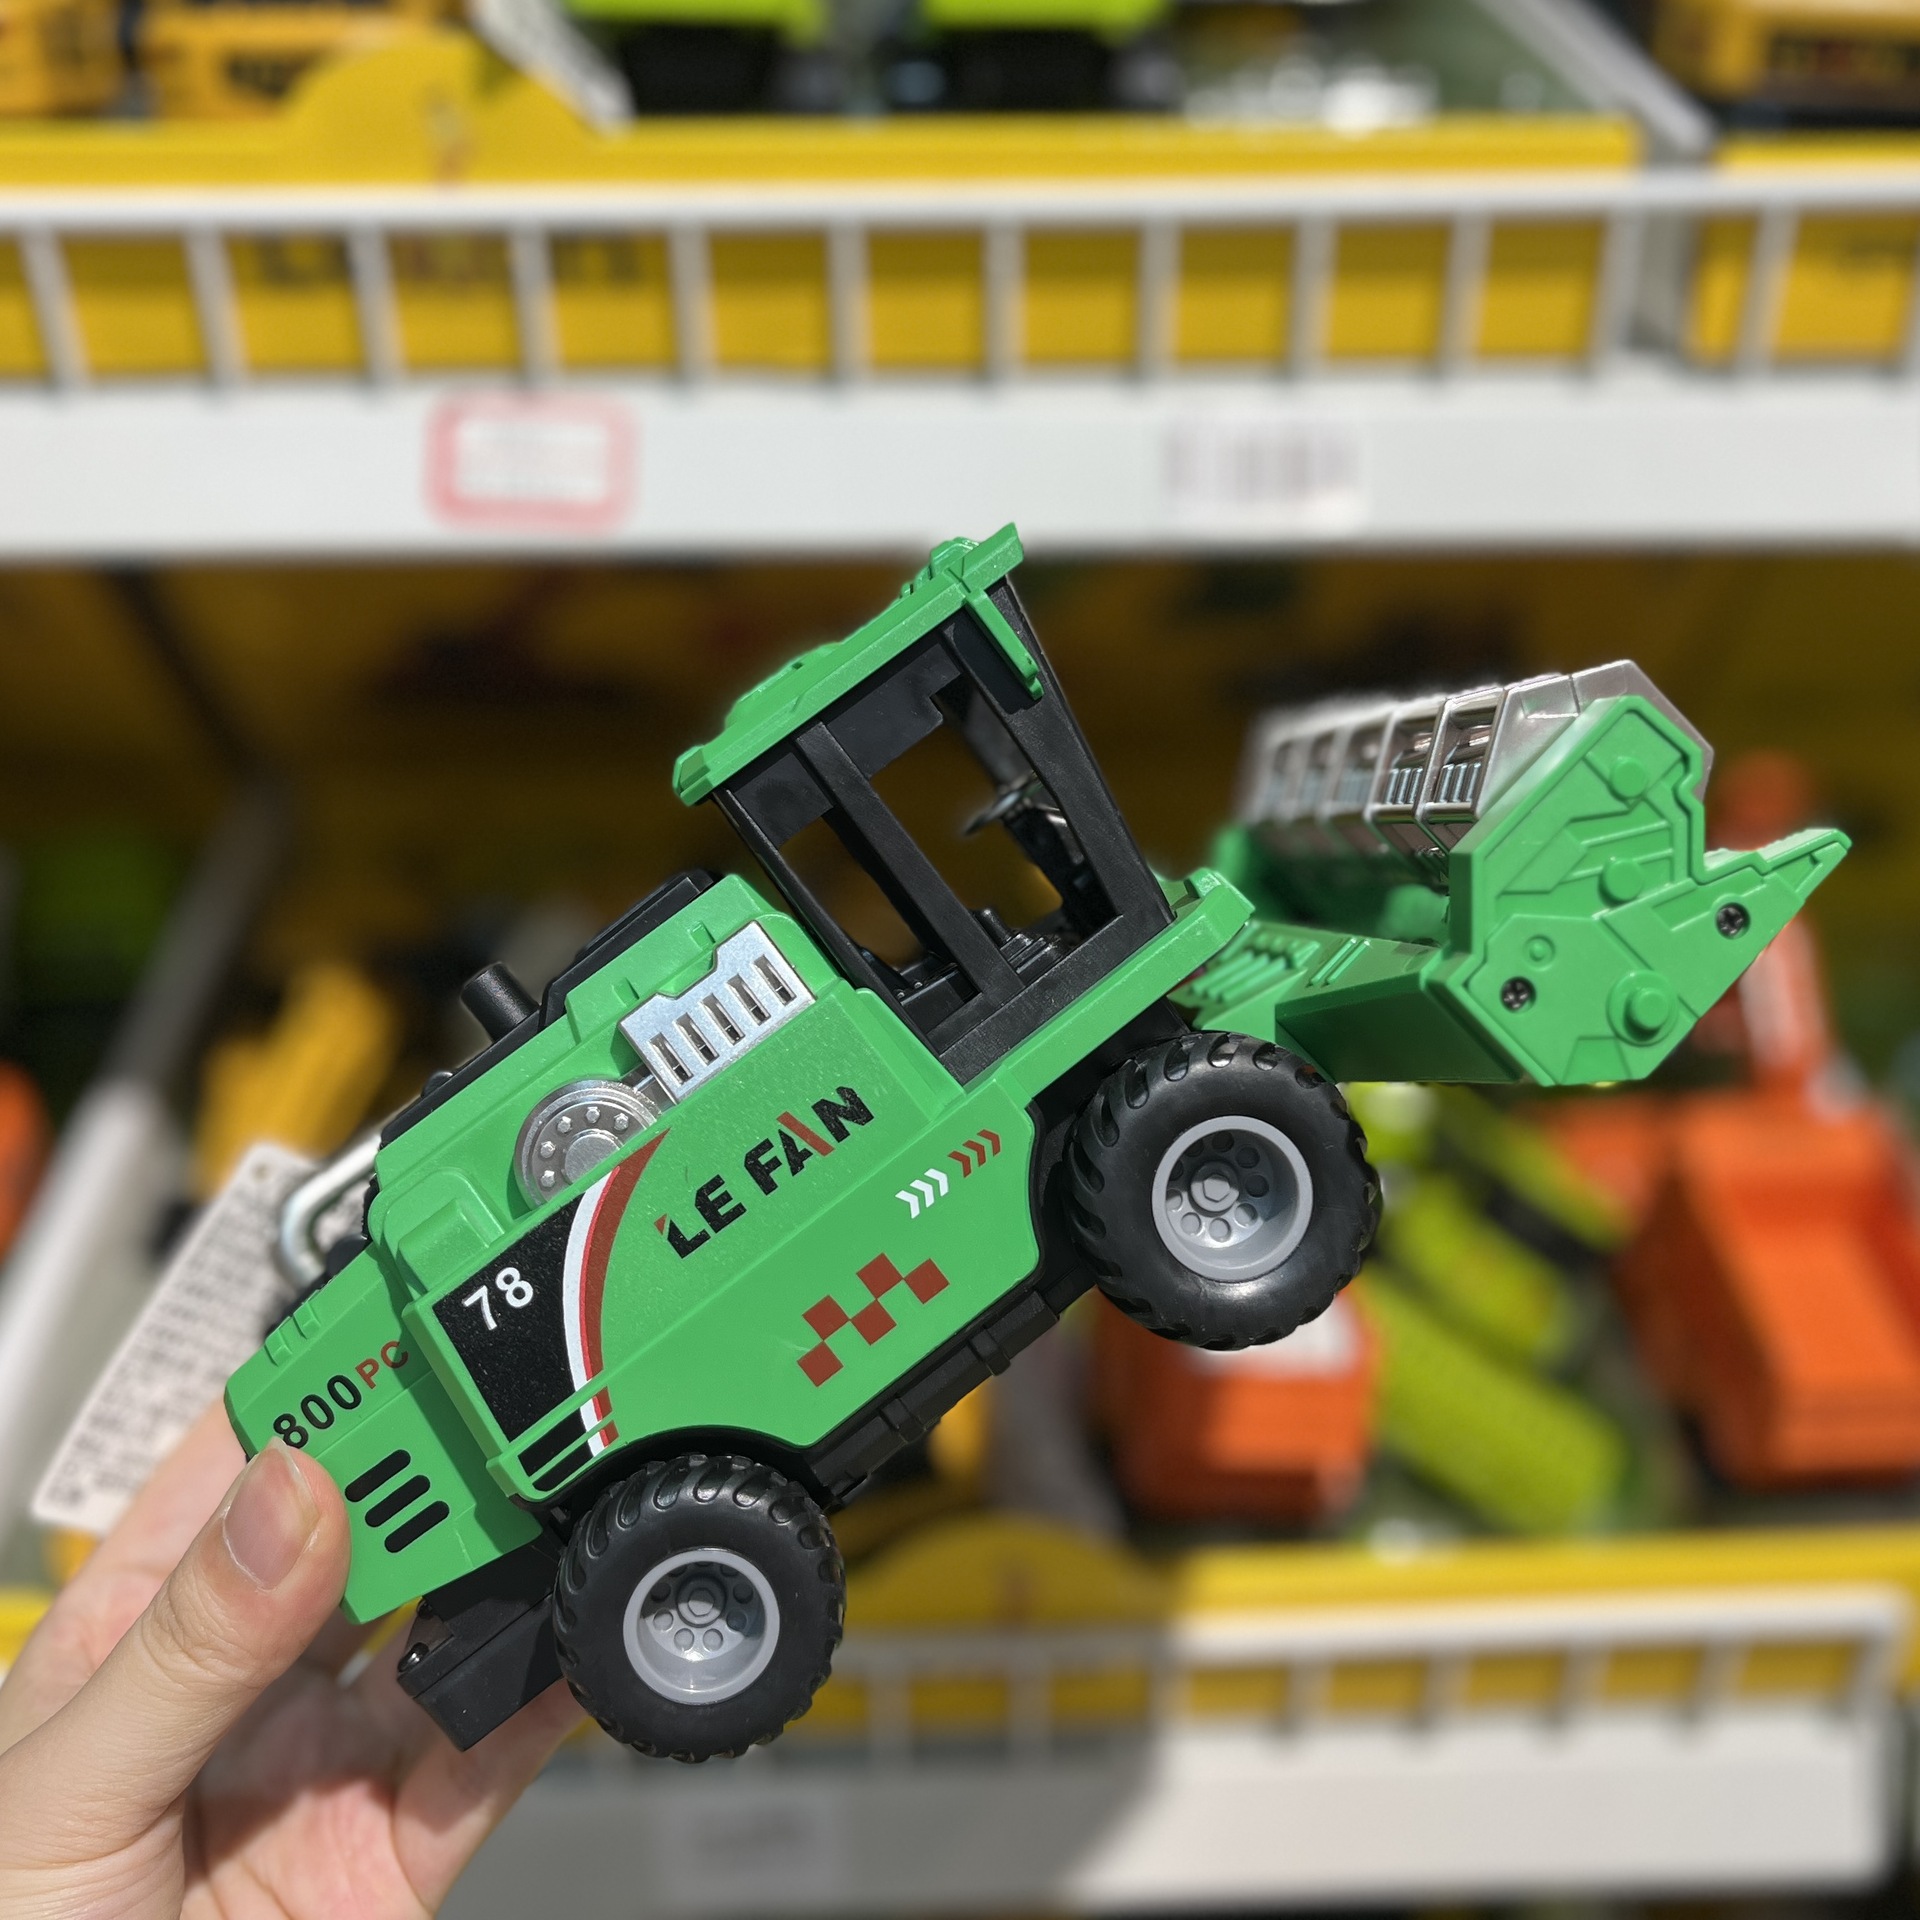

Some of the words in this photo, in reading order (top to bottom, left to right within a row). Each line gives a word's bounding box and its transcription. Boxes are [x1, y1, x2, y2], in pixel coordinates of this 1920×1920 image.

[654, 1174, 747, 1258] LE
[744, 1086, 874, 1195] FAN
[462, 1267, 533, 1330] 78
